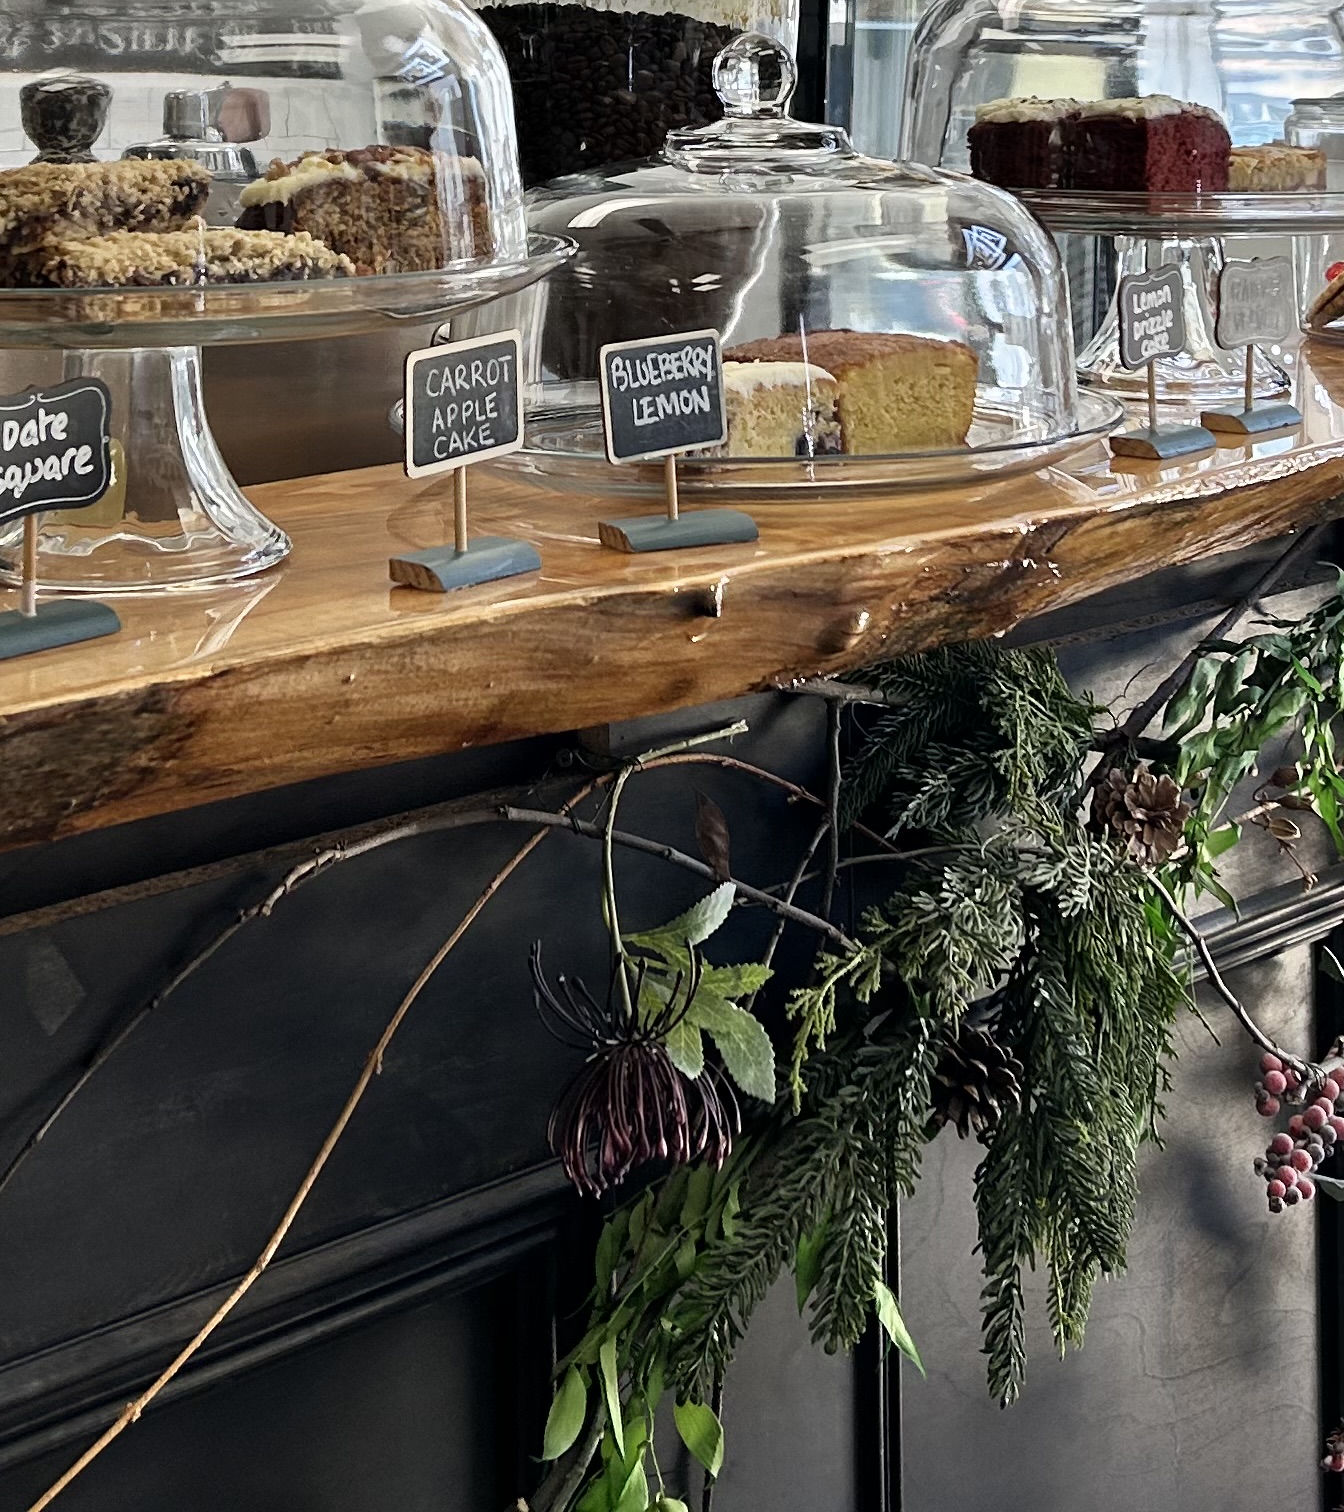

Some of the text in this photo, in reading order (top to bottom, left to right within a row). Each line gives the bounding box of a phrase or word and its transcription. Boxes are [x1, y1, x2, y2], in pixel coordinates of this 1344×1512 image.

[426, 355, 512, 398] CARROT
[611, 345, 715, 391] BLUEBERRY
[432, 391, 498, 433] APPLE
[633, 386, 711, 426] LEMON
[2, 408, 68, 451] Date
[433, 423, 496, 459] CAKE
